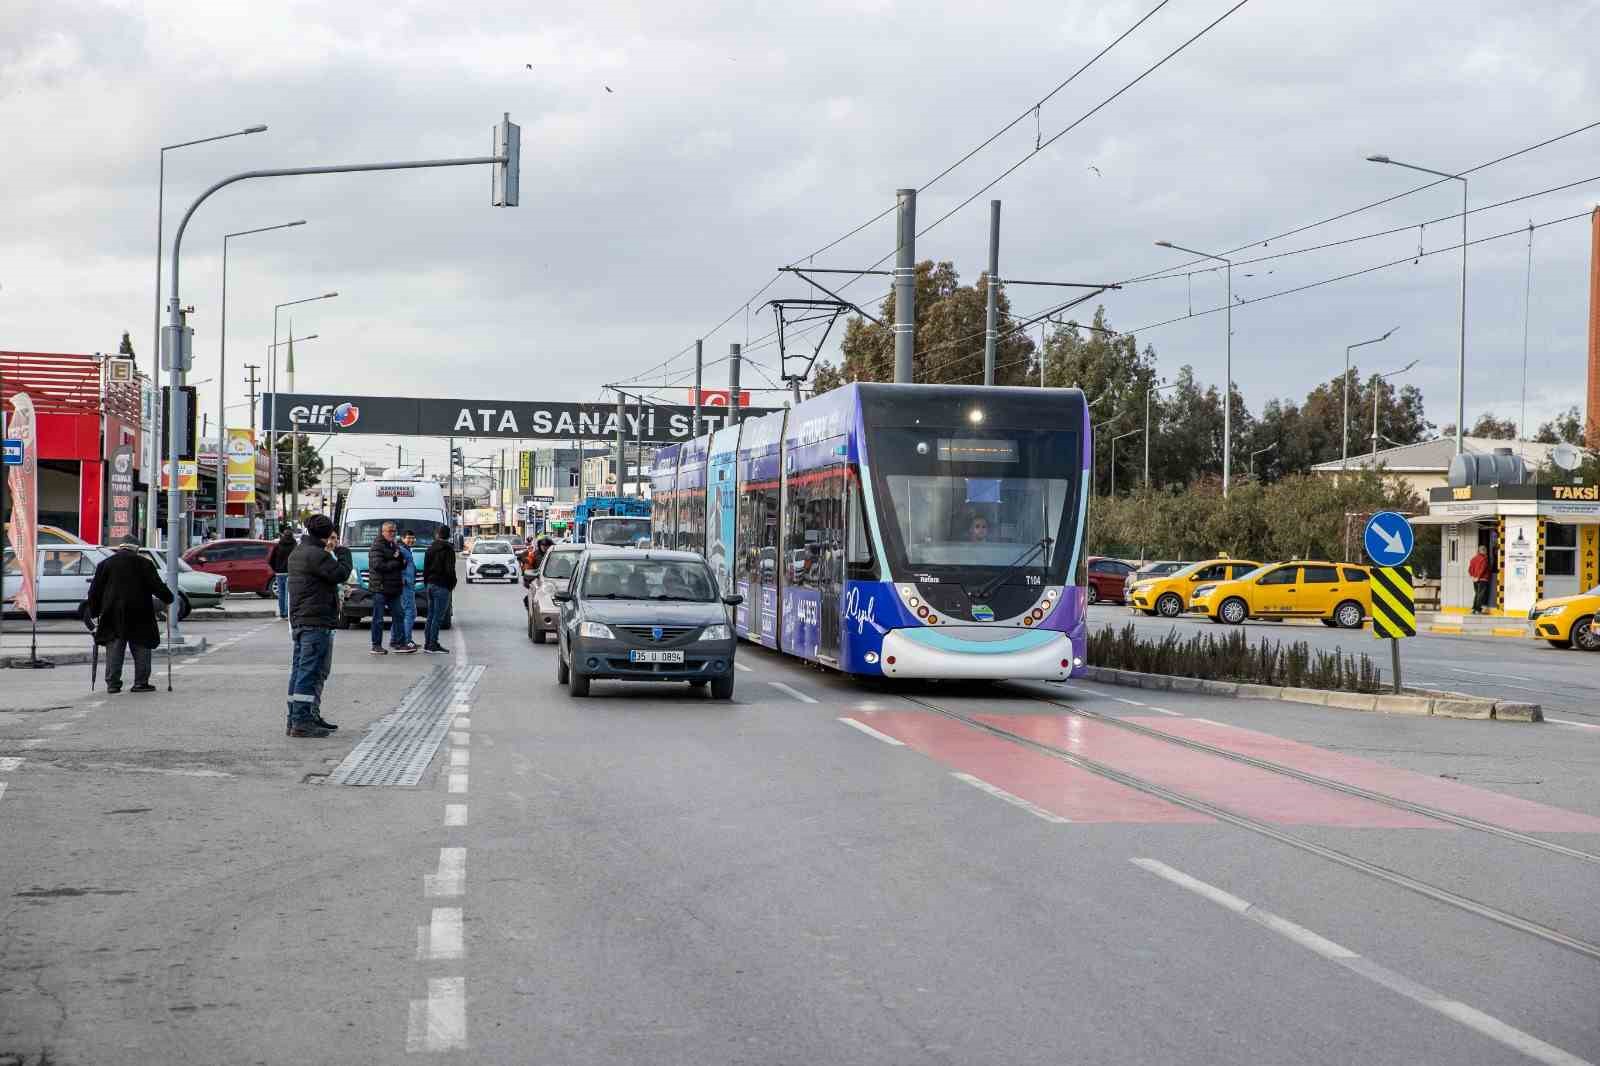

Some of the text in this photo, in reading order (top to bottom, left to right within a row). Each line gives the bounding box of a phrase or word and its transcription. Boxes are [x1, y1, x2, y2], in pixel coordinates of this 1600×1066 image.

[289, 404, 334, 425] elf
[454, 408, 518, 433] ATA
[532, 408, 655, 436] SANAYİ
[1552, 485, 1598, 500] TAKSİ
[1025, 576, 1041, 585] T104
[636, 653, 681, 662] 35 U 0894
